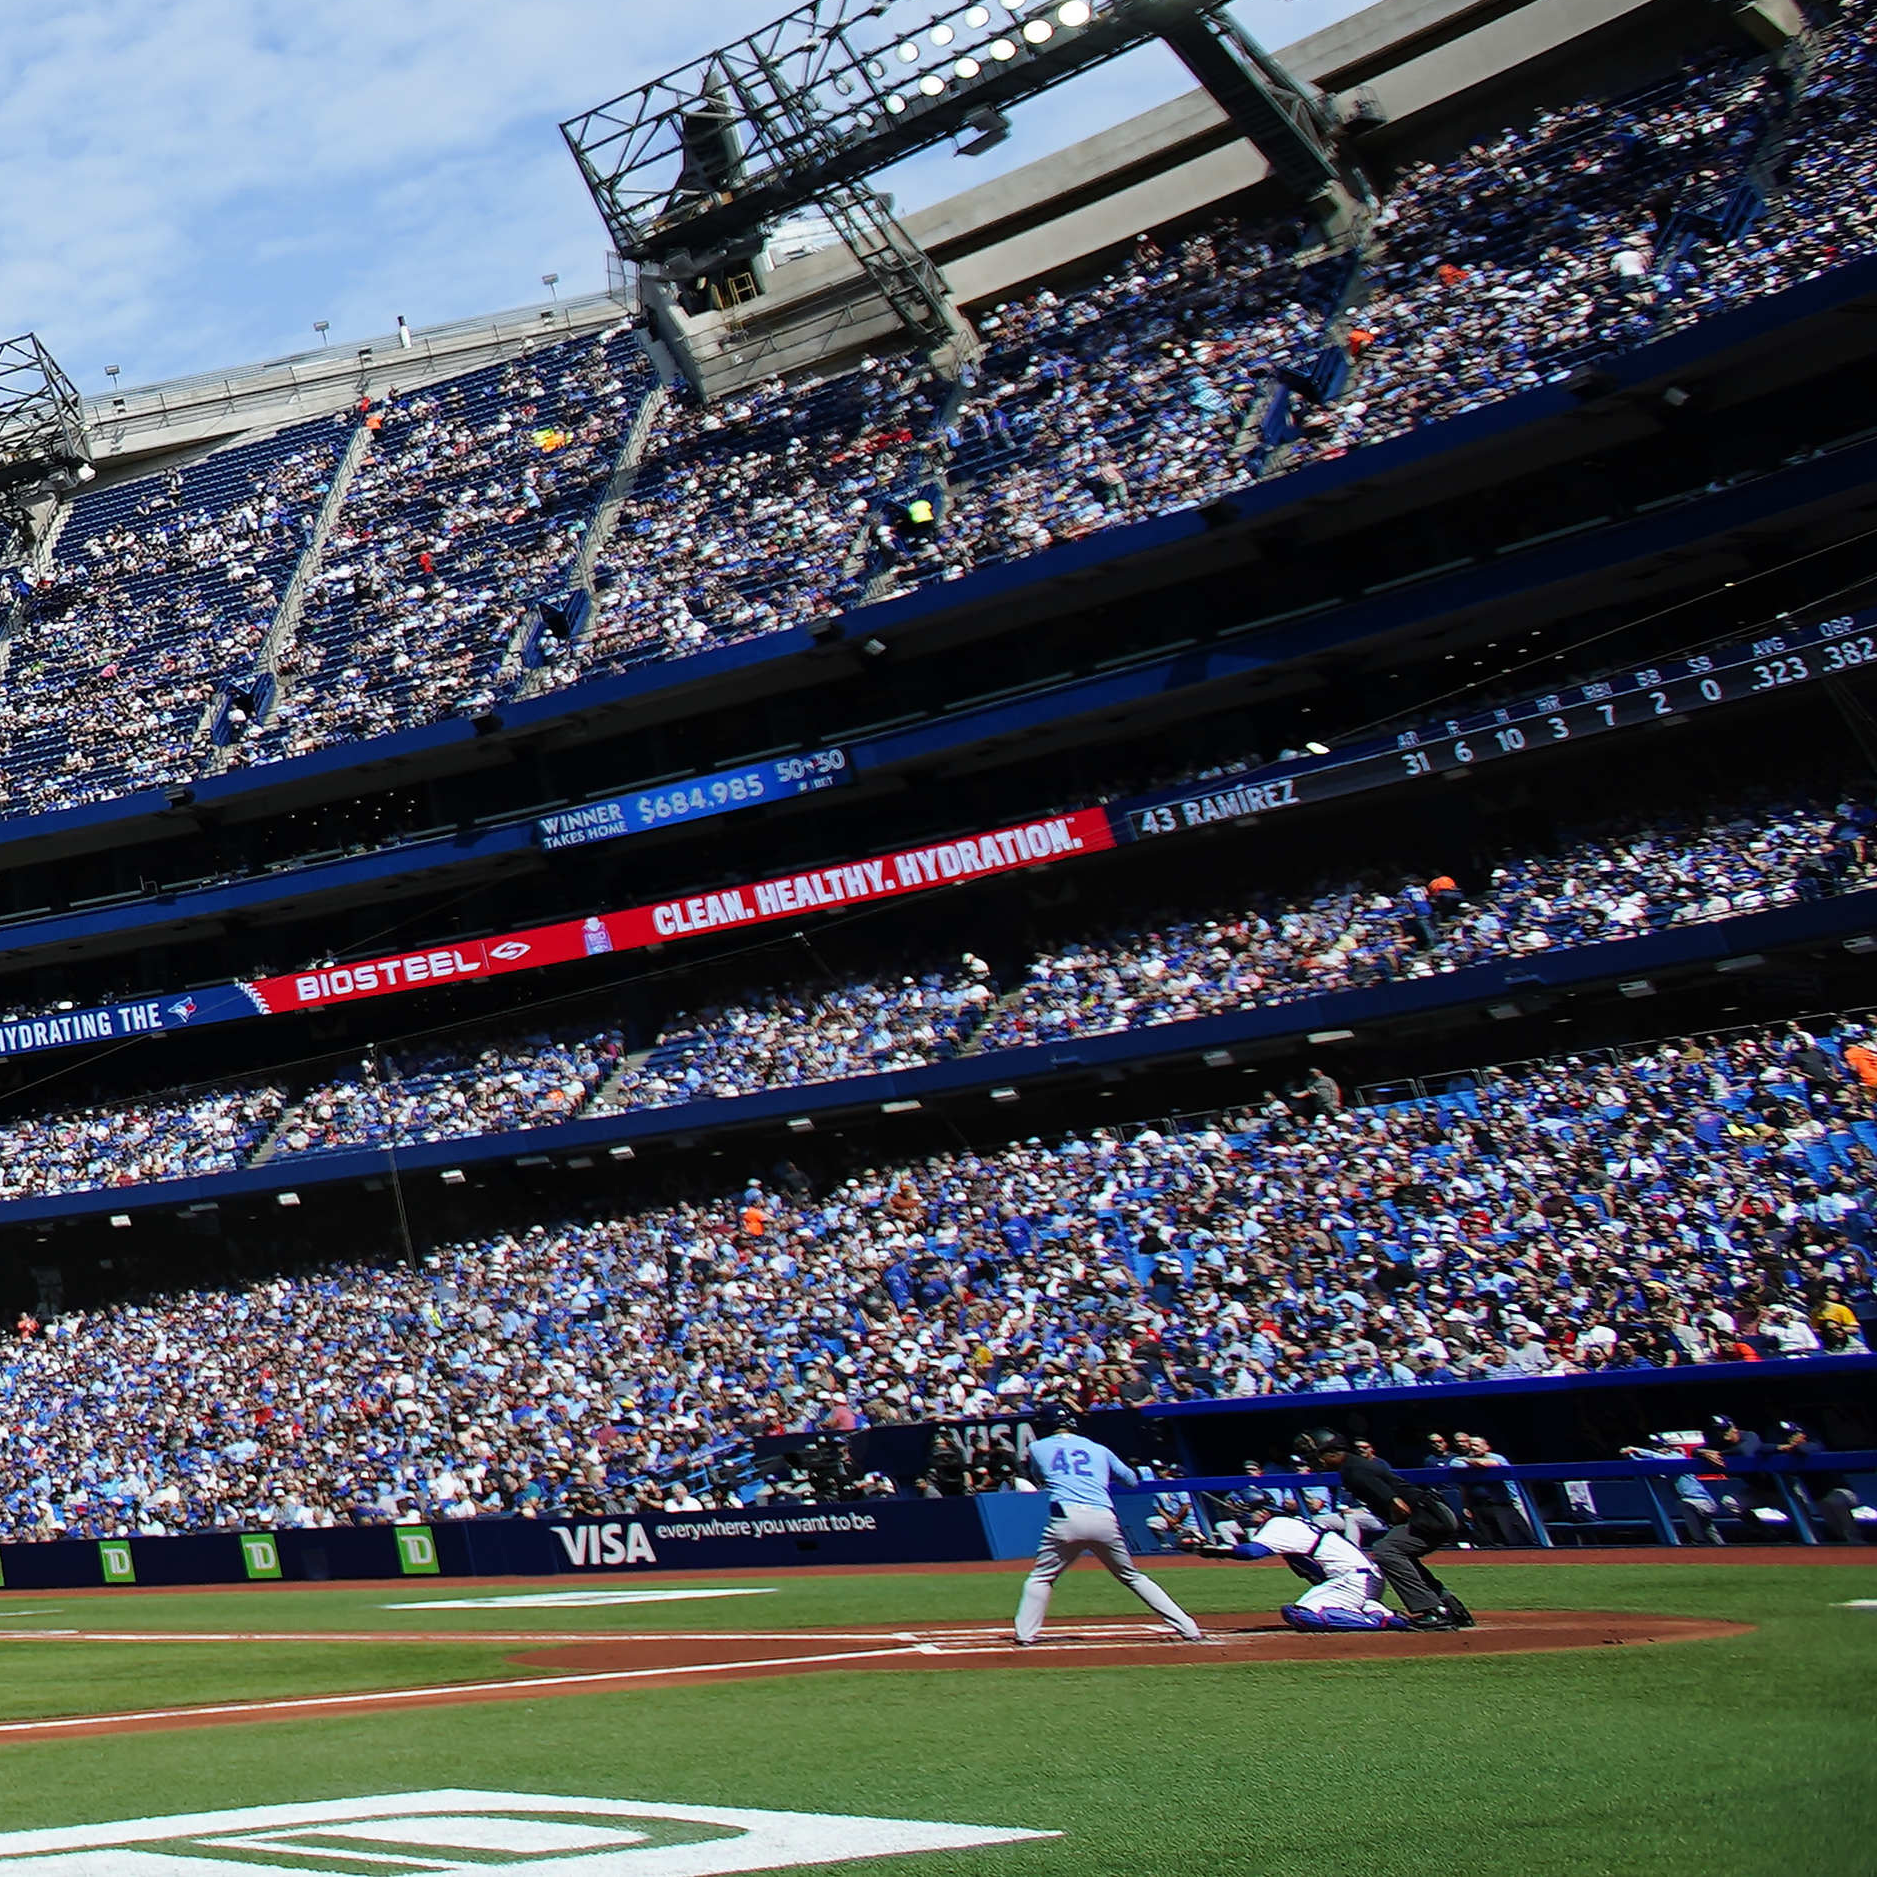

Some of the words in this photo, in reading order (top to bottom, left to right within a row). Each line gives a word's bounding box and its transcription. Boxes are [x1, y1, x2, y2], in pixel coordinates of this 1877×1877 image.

[1752, 657, 1809, 691] .323
[1822, 637, 1877, 673] .382
[1496, 728, 1526, 751] 10
[1401, 751, 1431, 775] 31
[541, 803, 624, 835] WINNER
[1141, 807, 1177, 834] 43
[544, 829, 586, 849] TAKES
[589, 821, 628, 840] HOME
[652, 890, 755, 935] CLEAN.
[755, 860, 897, 917] HEALTHY.
[296, 951, 481, 1003] BIOSTEEL
[118, 1003, 162, 1033] THE
[1051, 1448, 1093, 1477] 42
[403, 1537, 435, 1565] TD
[550, 1523, 657, 1565] VISA
[656, 1518, 750, 1540] everywhere
[753, 1519, 785, 1537] you
[788, 1516, 828, 1532] want
[830, 1515, 847, 1530] to
[849, 1513, 876, 1530] be
[103, 1549, 130, 1574] TD
[247, 1543, 276, 1569] TD
